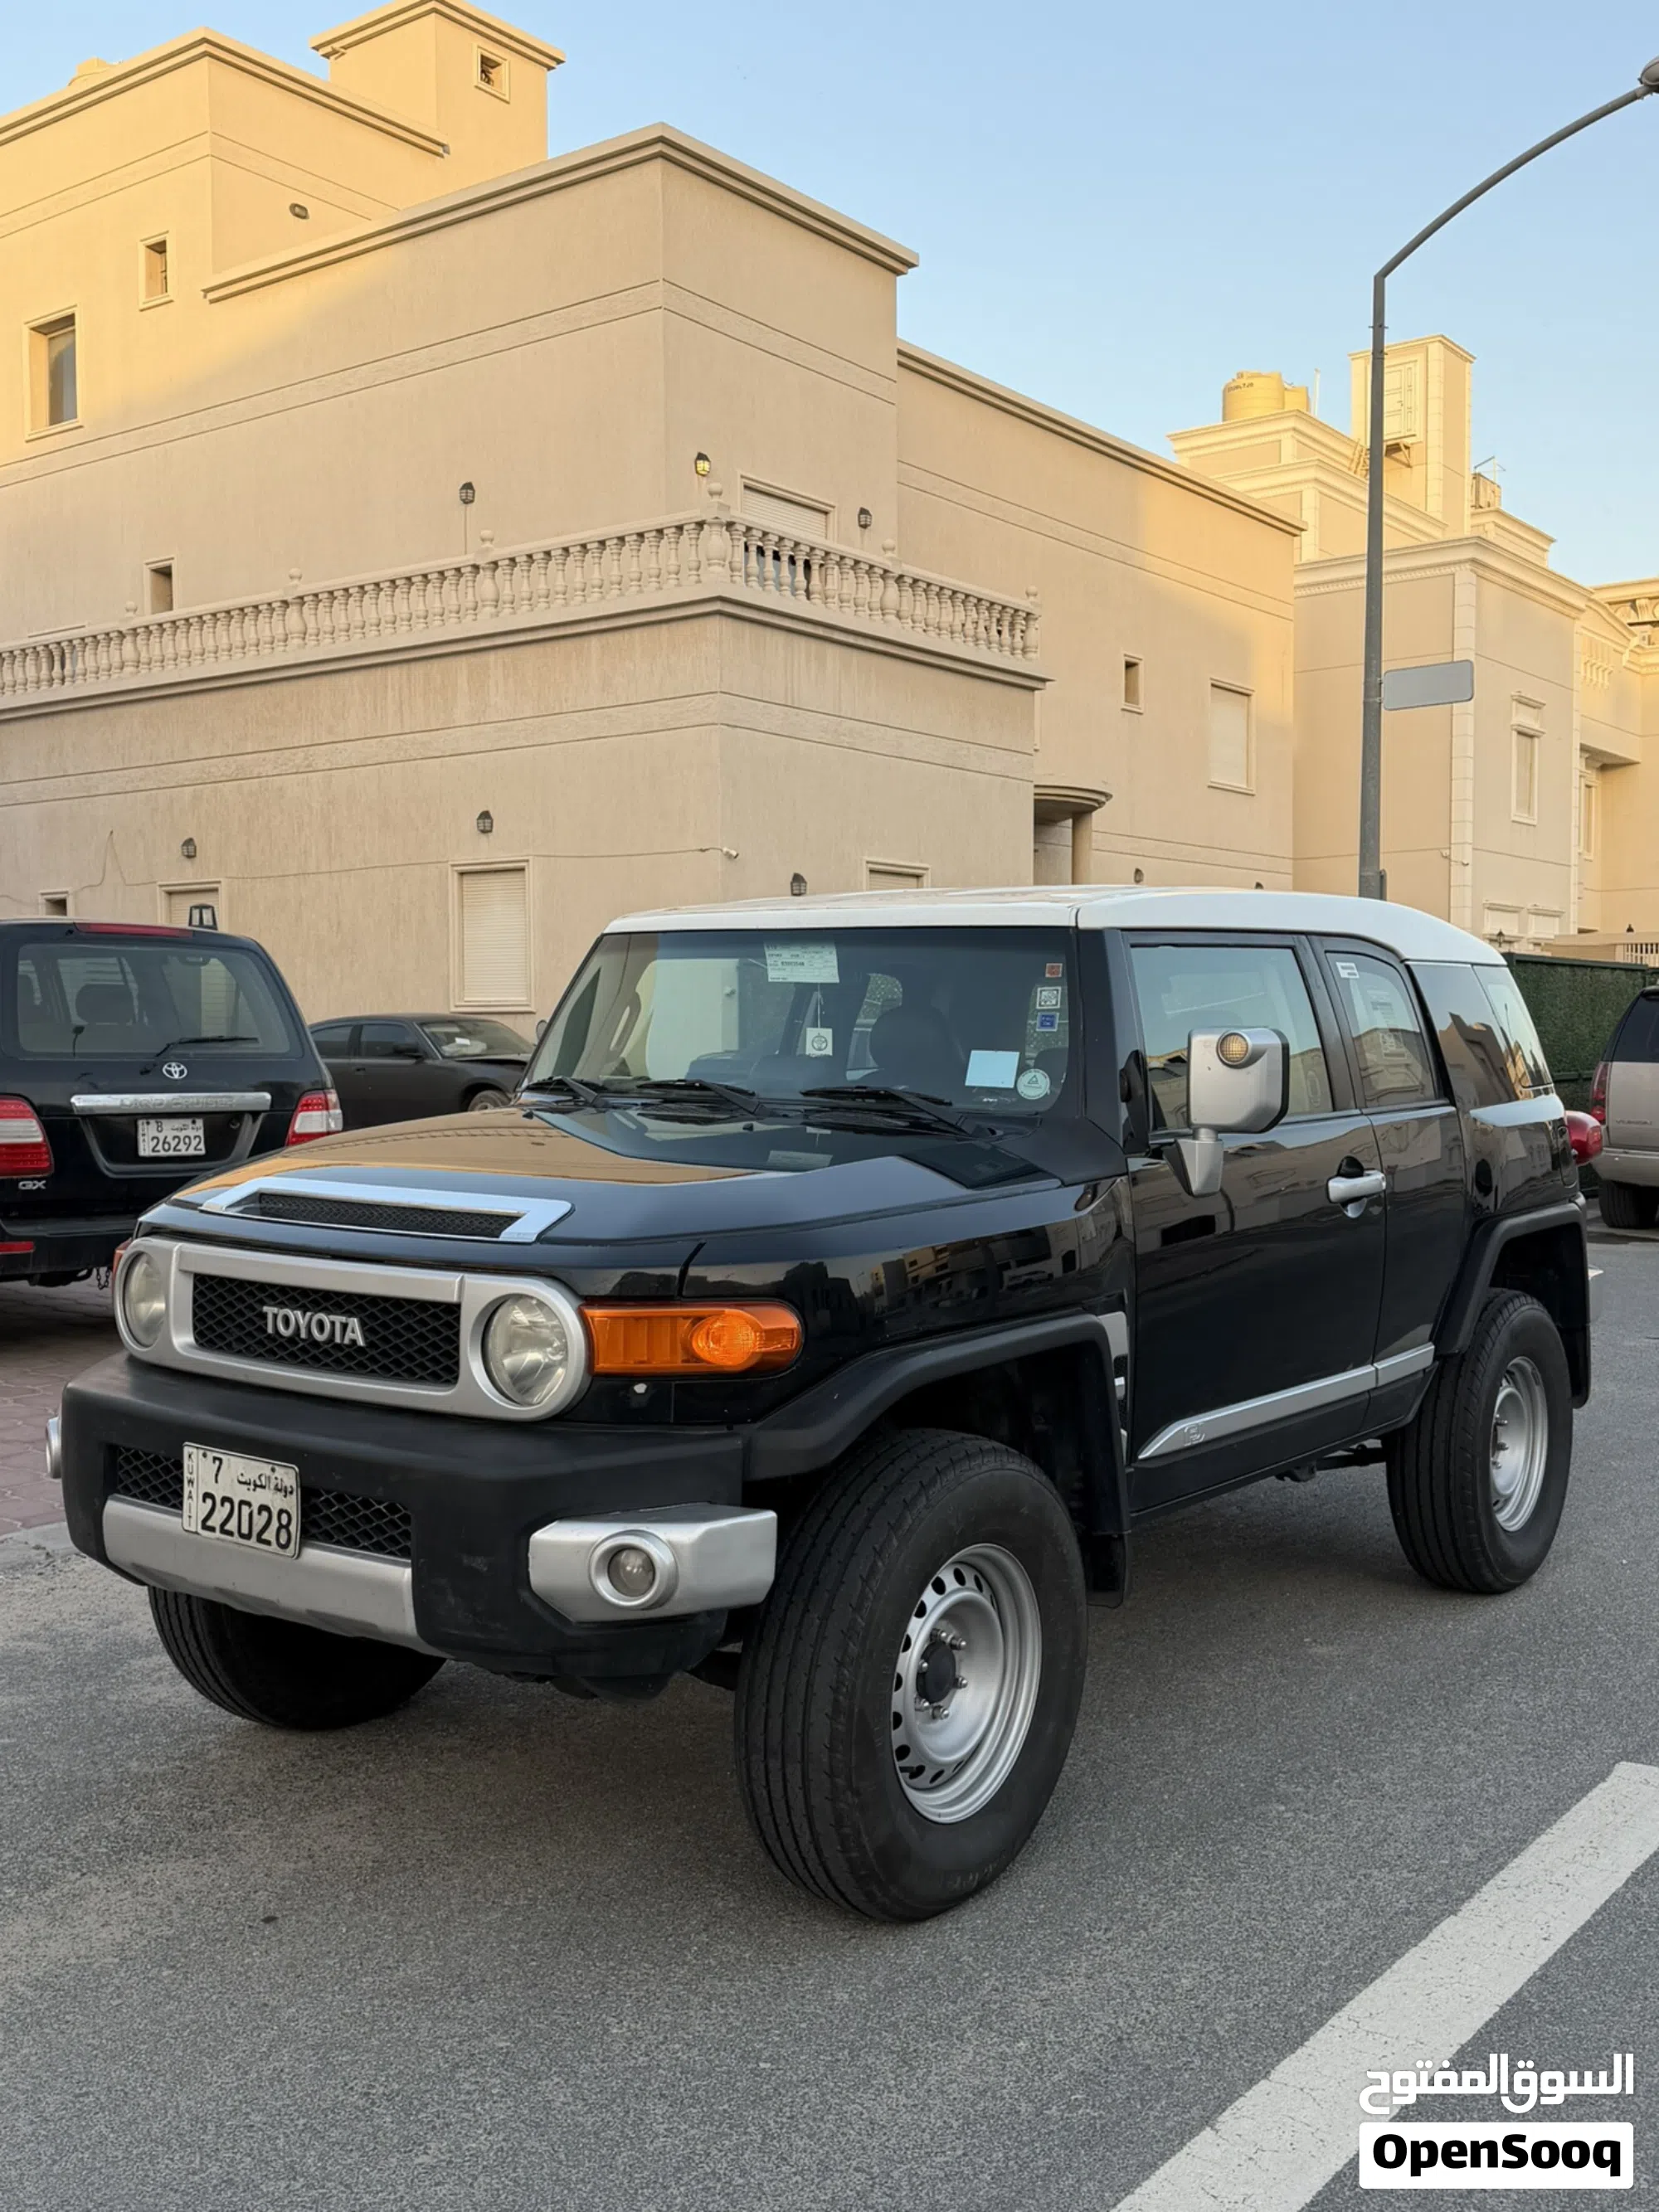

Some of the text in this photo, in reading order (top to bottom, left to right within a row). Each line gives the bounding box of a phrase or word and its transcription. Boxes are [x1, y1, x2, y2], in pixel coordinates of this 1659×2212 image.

[156, 1121, 163, 1133] 8
[151, 1135, 203, 1153] 26292
[18, 1179, 46, 1190] GX
[262, 1305, 366, 1347] TOYOTA
[212, 1456, 223, 1485] 7
[187, 1451, 195, 1528] KUWAIT
[236, 1472, 294, 1499] دولة الكويت
[201, 1491, 293, 1550] 22028
